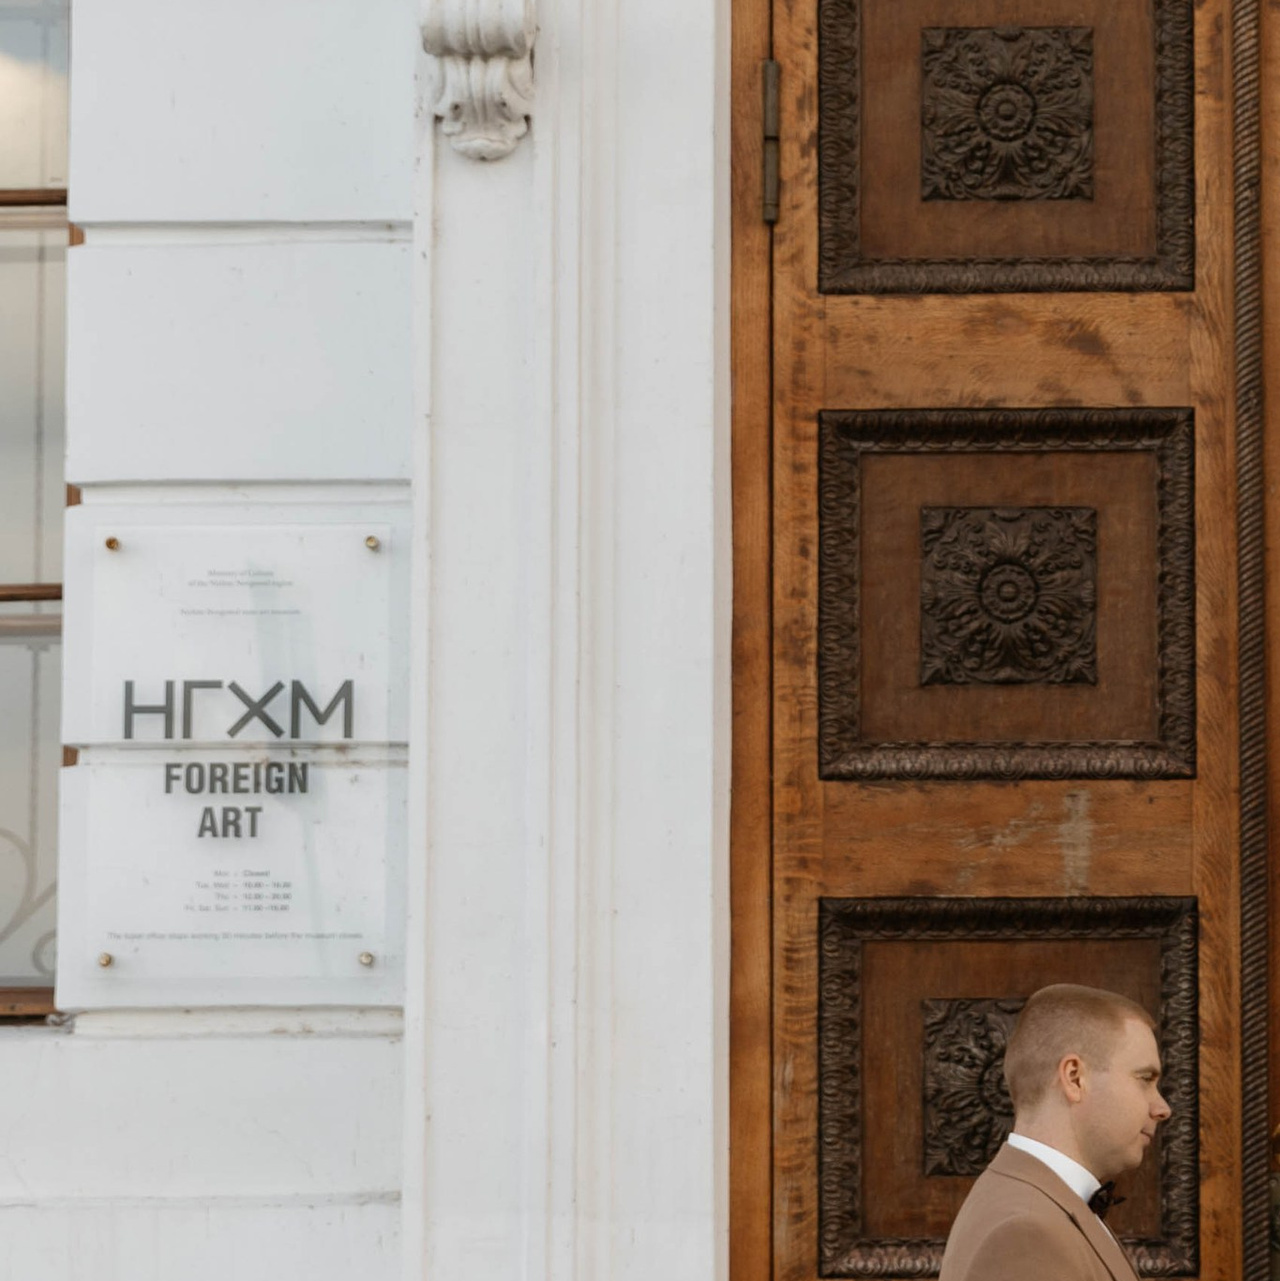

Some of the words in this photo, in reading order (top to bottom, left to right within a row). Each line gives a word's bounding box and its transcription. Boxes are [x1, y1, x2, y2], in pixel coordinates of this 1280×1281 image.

[124, 680, 354, 739] НГХМ
[165, 762, 309, 794] FOREIGN
[197, 806, 263, 838] ART
